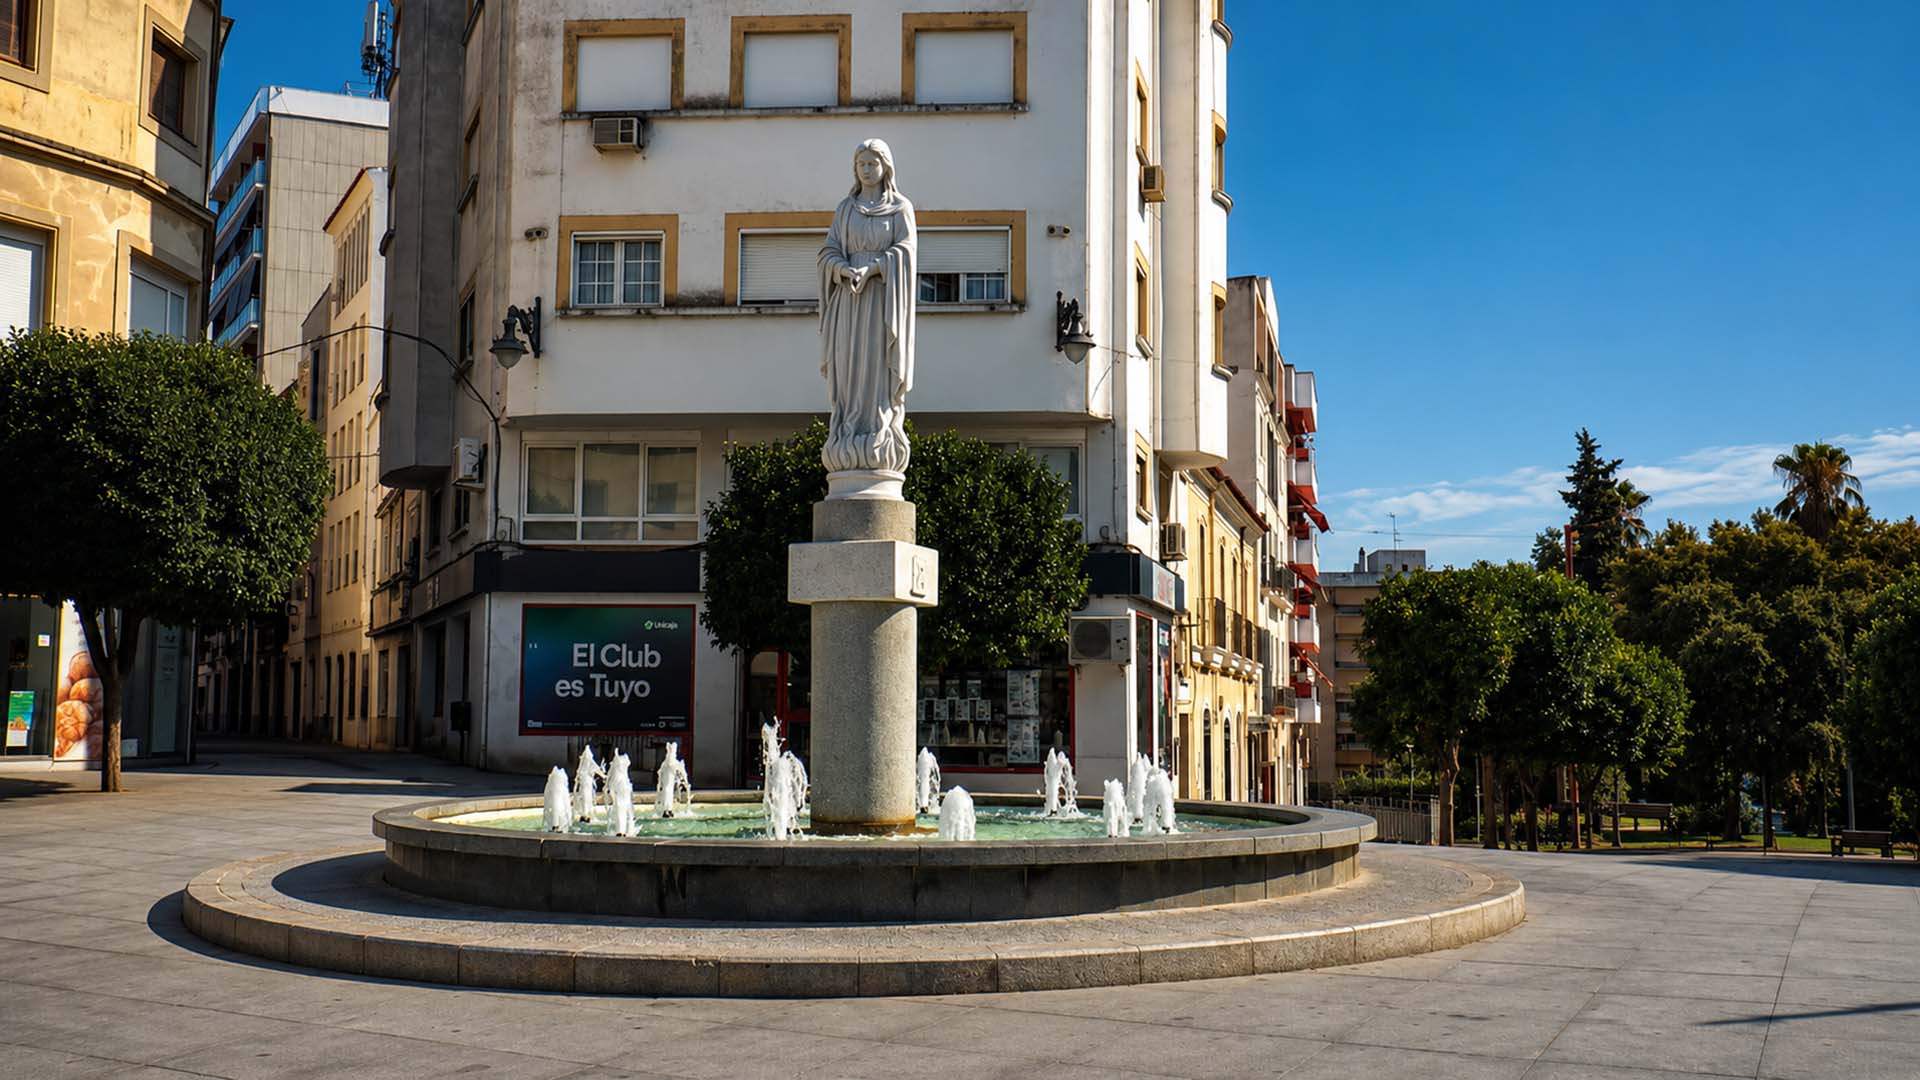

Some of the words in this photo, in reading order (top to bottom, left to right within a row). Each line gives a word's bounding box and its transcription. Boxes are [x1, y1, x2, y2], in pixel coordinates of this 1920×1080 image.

[654, 621, 678, 630] Unicaja
[572, 643, 595, 668] El
[600, 643, 662, 668] Club
[554, 679, 585, 698] es
[589, 673, 651, 703] Tuyo
